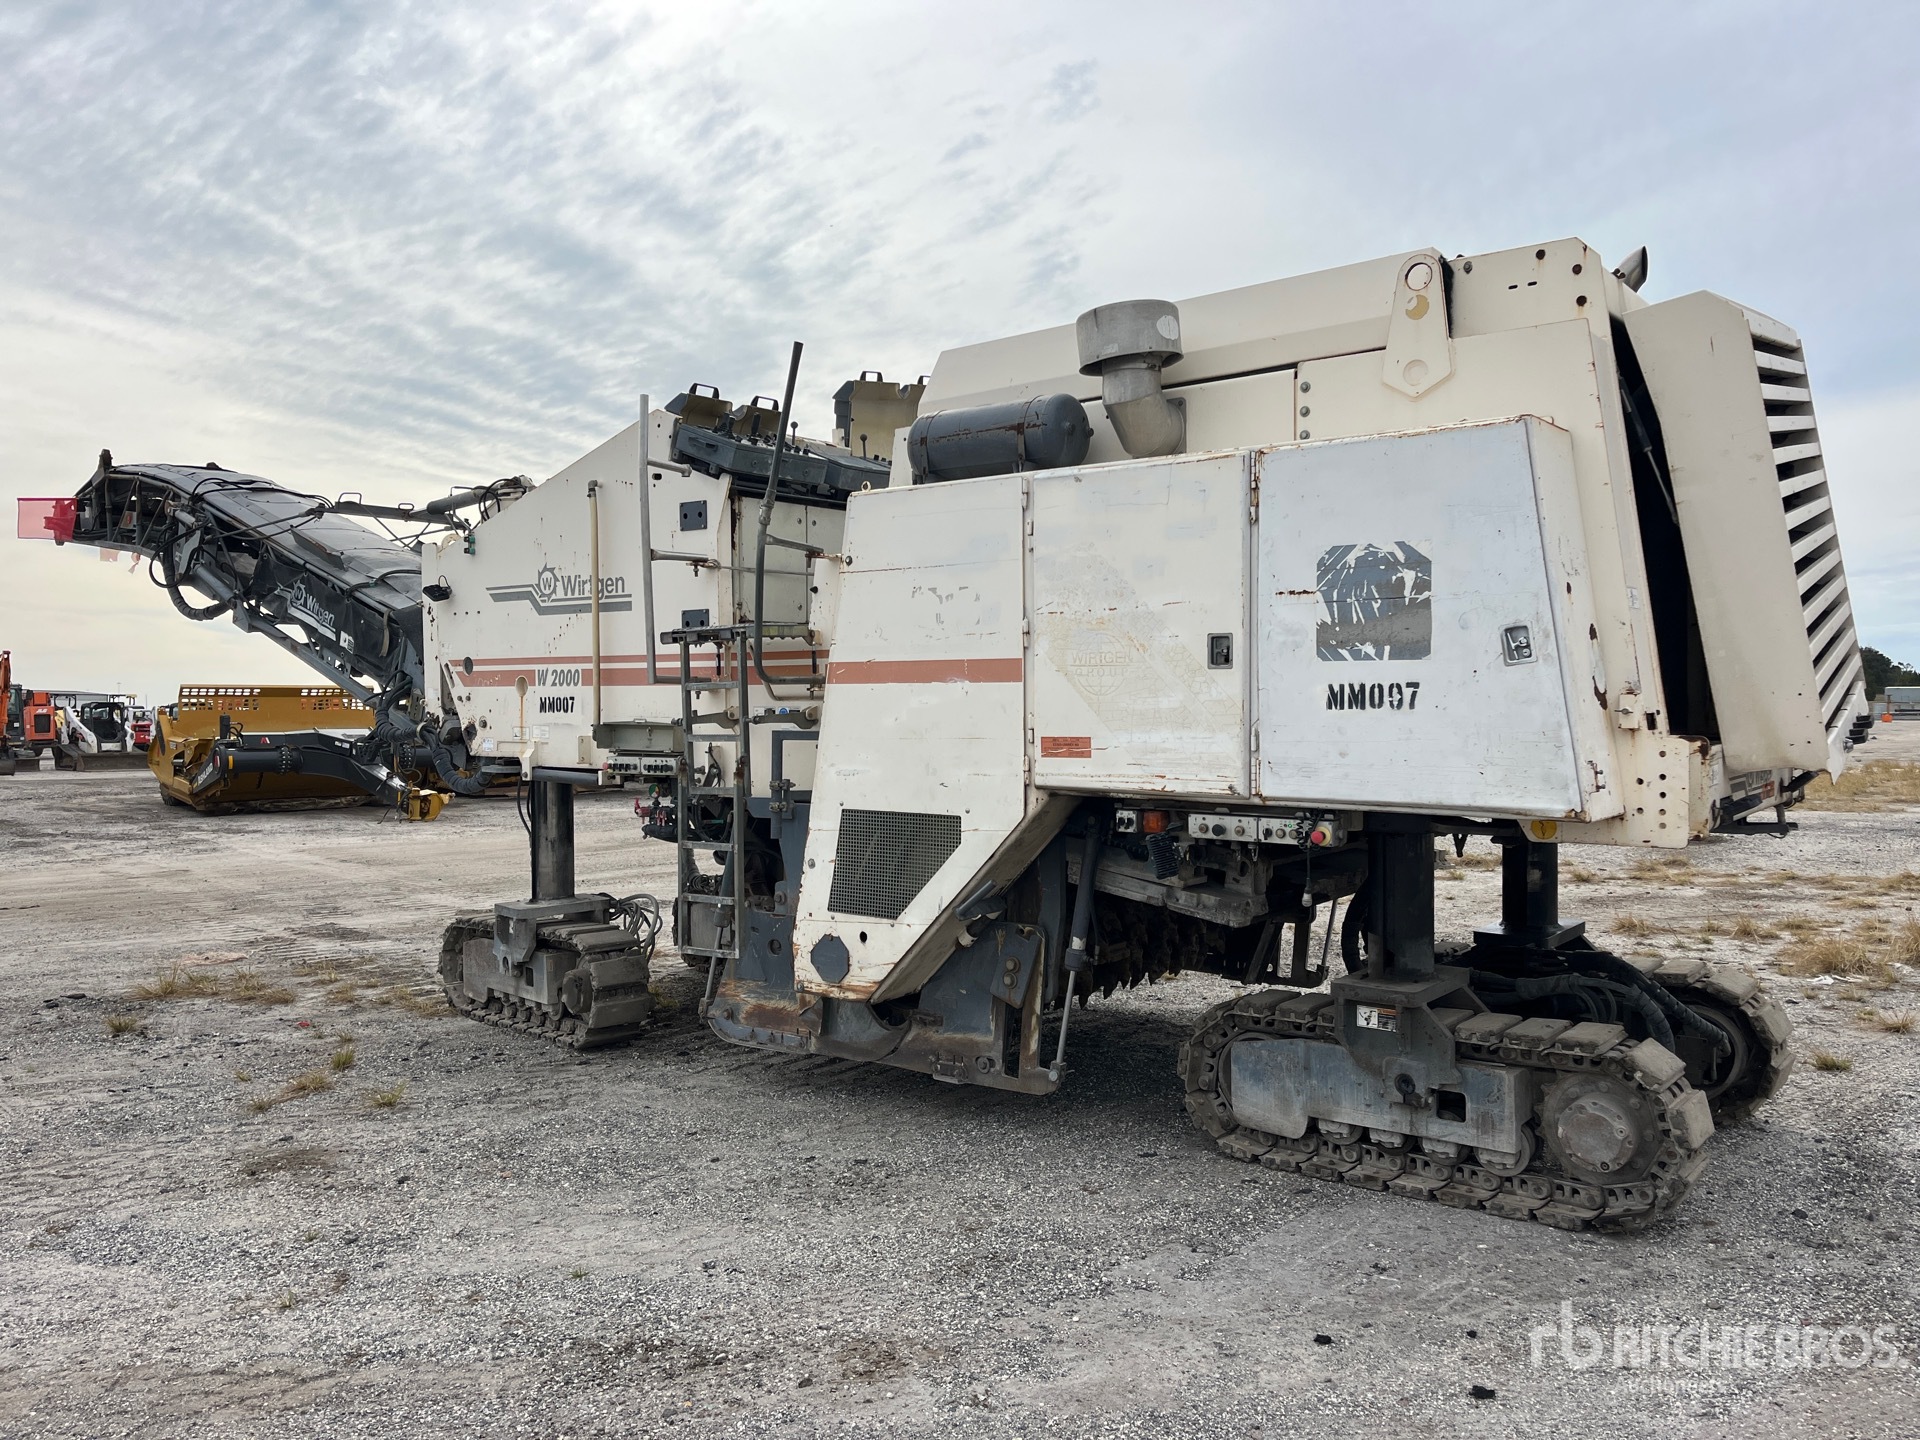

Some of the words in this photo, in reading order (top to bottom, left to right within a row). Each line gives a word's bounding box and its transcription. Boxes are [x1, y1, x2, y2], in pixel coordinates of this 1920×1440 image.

[537, 668, 548, 687] W
[551, 669, 580, 687] 2000
[539, 696, 575, 713] MM007
[1326, 682, 1420, 711] MM007
